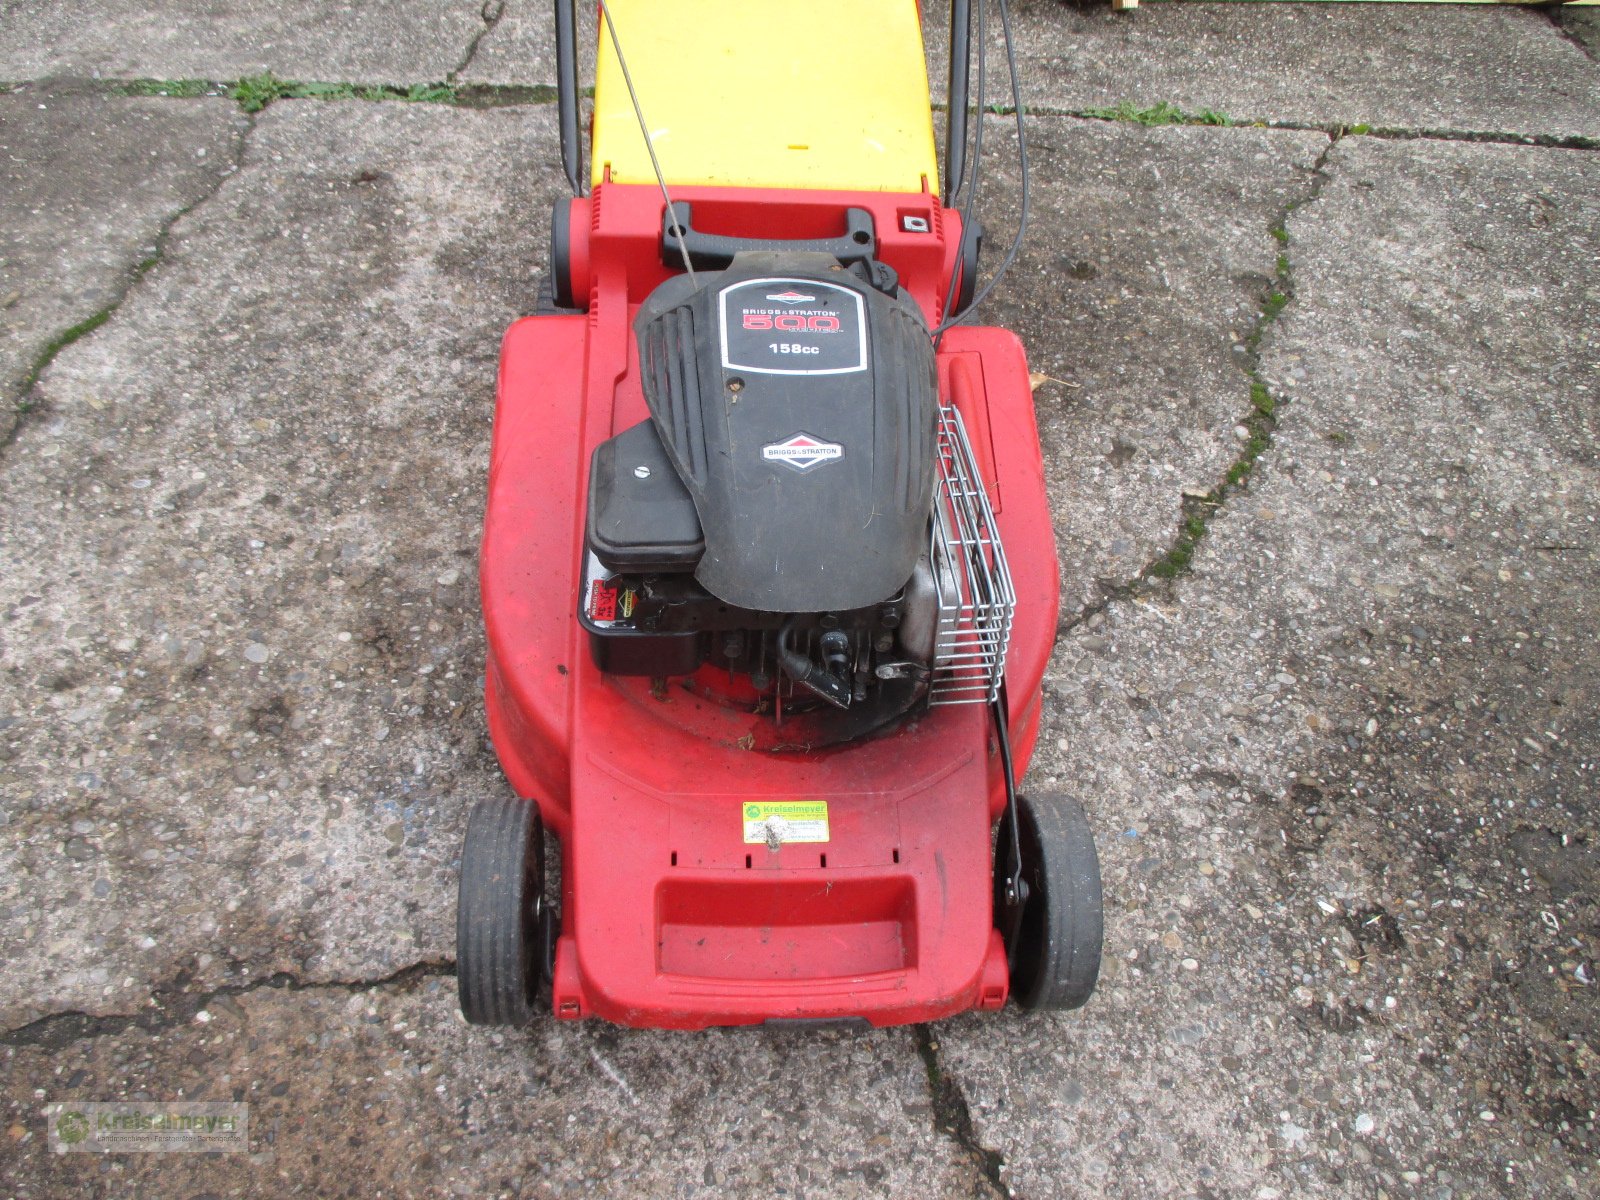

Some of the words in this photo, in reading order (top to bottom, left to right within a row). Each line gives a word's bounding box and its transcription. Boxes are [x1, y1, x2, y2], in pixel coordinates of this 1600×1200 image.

[743, 314, 840, 330] 500
[769, 343, 820, 354] 158cc
[763, 805, 825, 813] Kreiselmeyer
